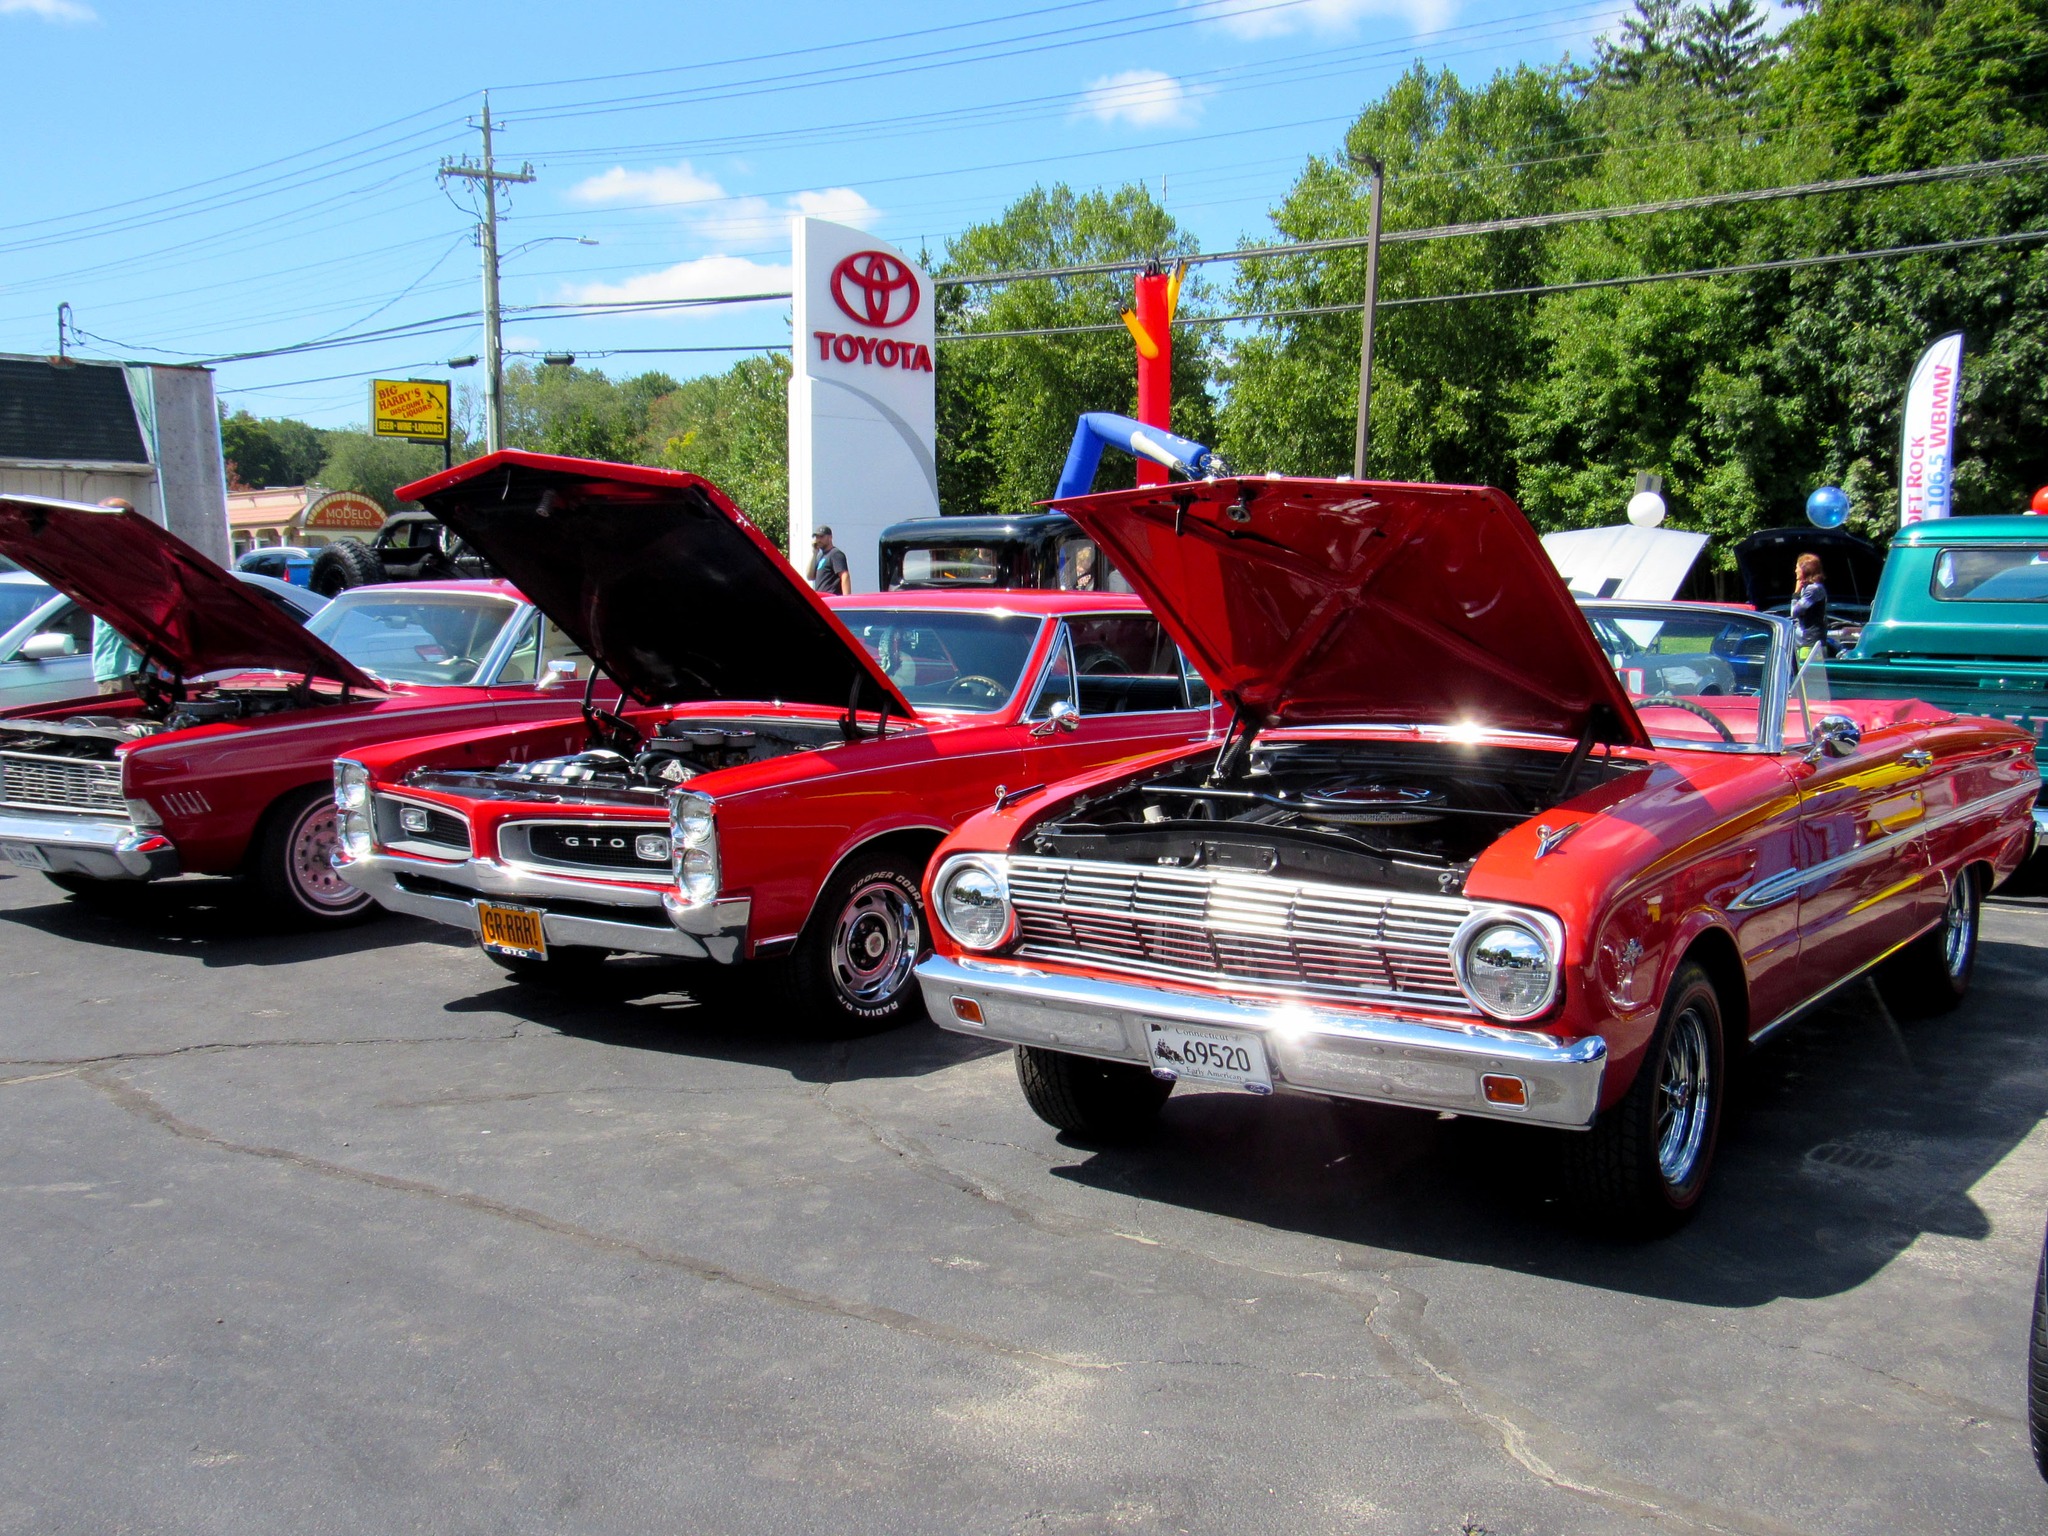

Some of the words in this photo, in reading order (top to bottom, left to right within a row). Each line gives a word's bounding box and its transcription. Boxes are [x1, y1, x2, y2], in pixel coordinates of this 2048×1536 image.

[813, 331, 933, 373] TOYOTA
[377, 385, 398, 400] BIG
[378, 388, 421, 411] HARRY'S
[390, 398, 424, 416] DISCOUNT
[402, 402, 433, 418] LIQUORS
[1929, 364, 1952, 449] WBMW
[1906, 434, 1925, 488] ROCK
[1927, 453, 1947, 508] 106.5
[326, 508, 372, 520] MODELO
[350, 519, 371, 527] GRILL
[565, 837, 625, 848] GTO
[850, 871, 895, 894] COOPER
[895, 875, 925, 909] COBRA
[502, 947, 528, 957] GTO
[856, 1001, 899, 1017] RADIAL
[1175, 1028, 1230, 1041] Connecticut
[1183, 1040, 1251, 1072] 69520
[1186, 1066, 1205, 1077] Early
[1207, 1070, 1243, 1081] American
